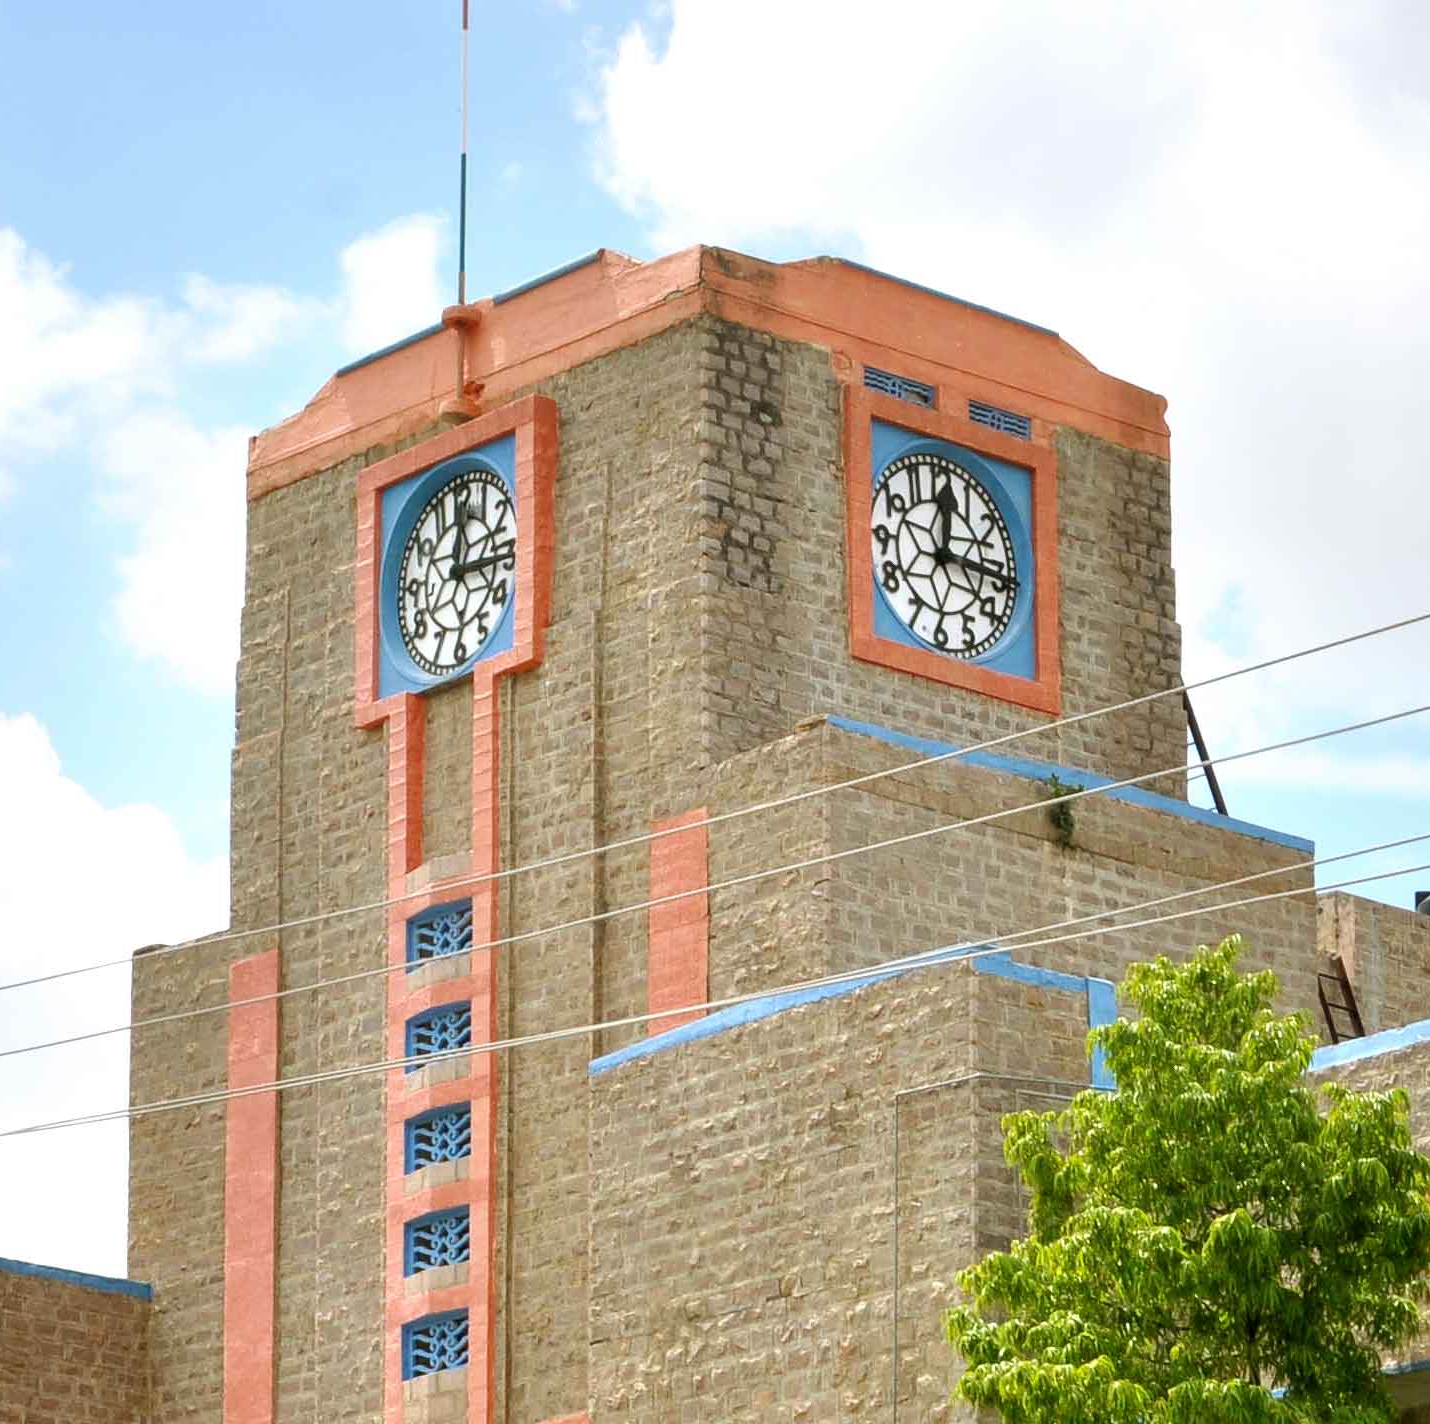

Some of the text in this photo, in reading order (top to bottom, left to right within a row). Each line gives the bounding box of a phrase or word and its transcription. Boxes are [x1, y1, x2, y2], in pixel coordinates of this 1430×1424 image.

[885, 481, 906, 518] 10
[494, 499, 508, 535] 2
[980, 513, 995, 549] 2
[415, 531, 433, 567] 10
[874, 525, 890, 556] 9
[407, 578, 421, 608] 9
[490, 579, 507, 608] 4
[882, 561, 899, 593] 8
[414, 608, 427, 639] 8
[477, 611, 489, 645] 5
[908, 597, 924, 628] 7
[979, 597, 1003, 627] 4
[454, 627, 467, 664] 6
[934, 615, 948, 649] 6
[962, 613, 975, 648] 5
[434, 631, 447, 665] 7
